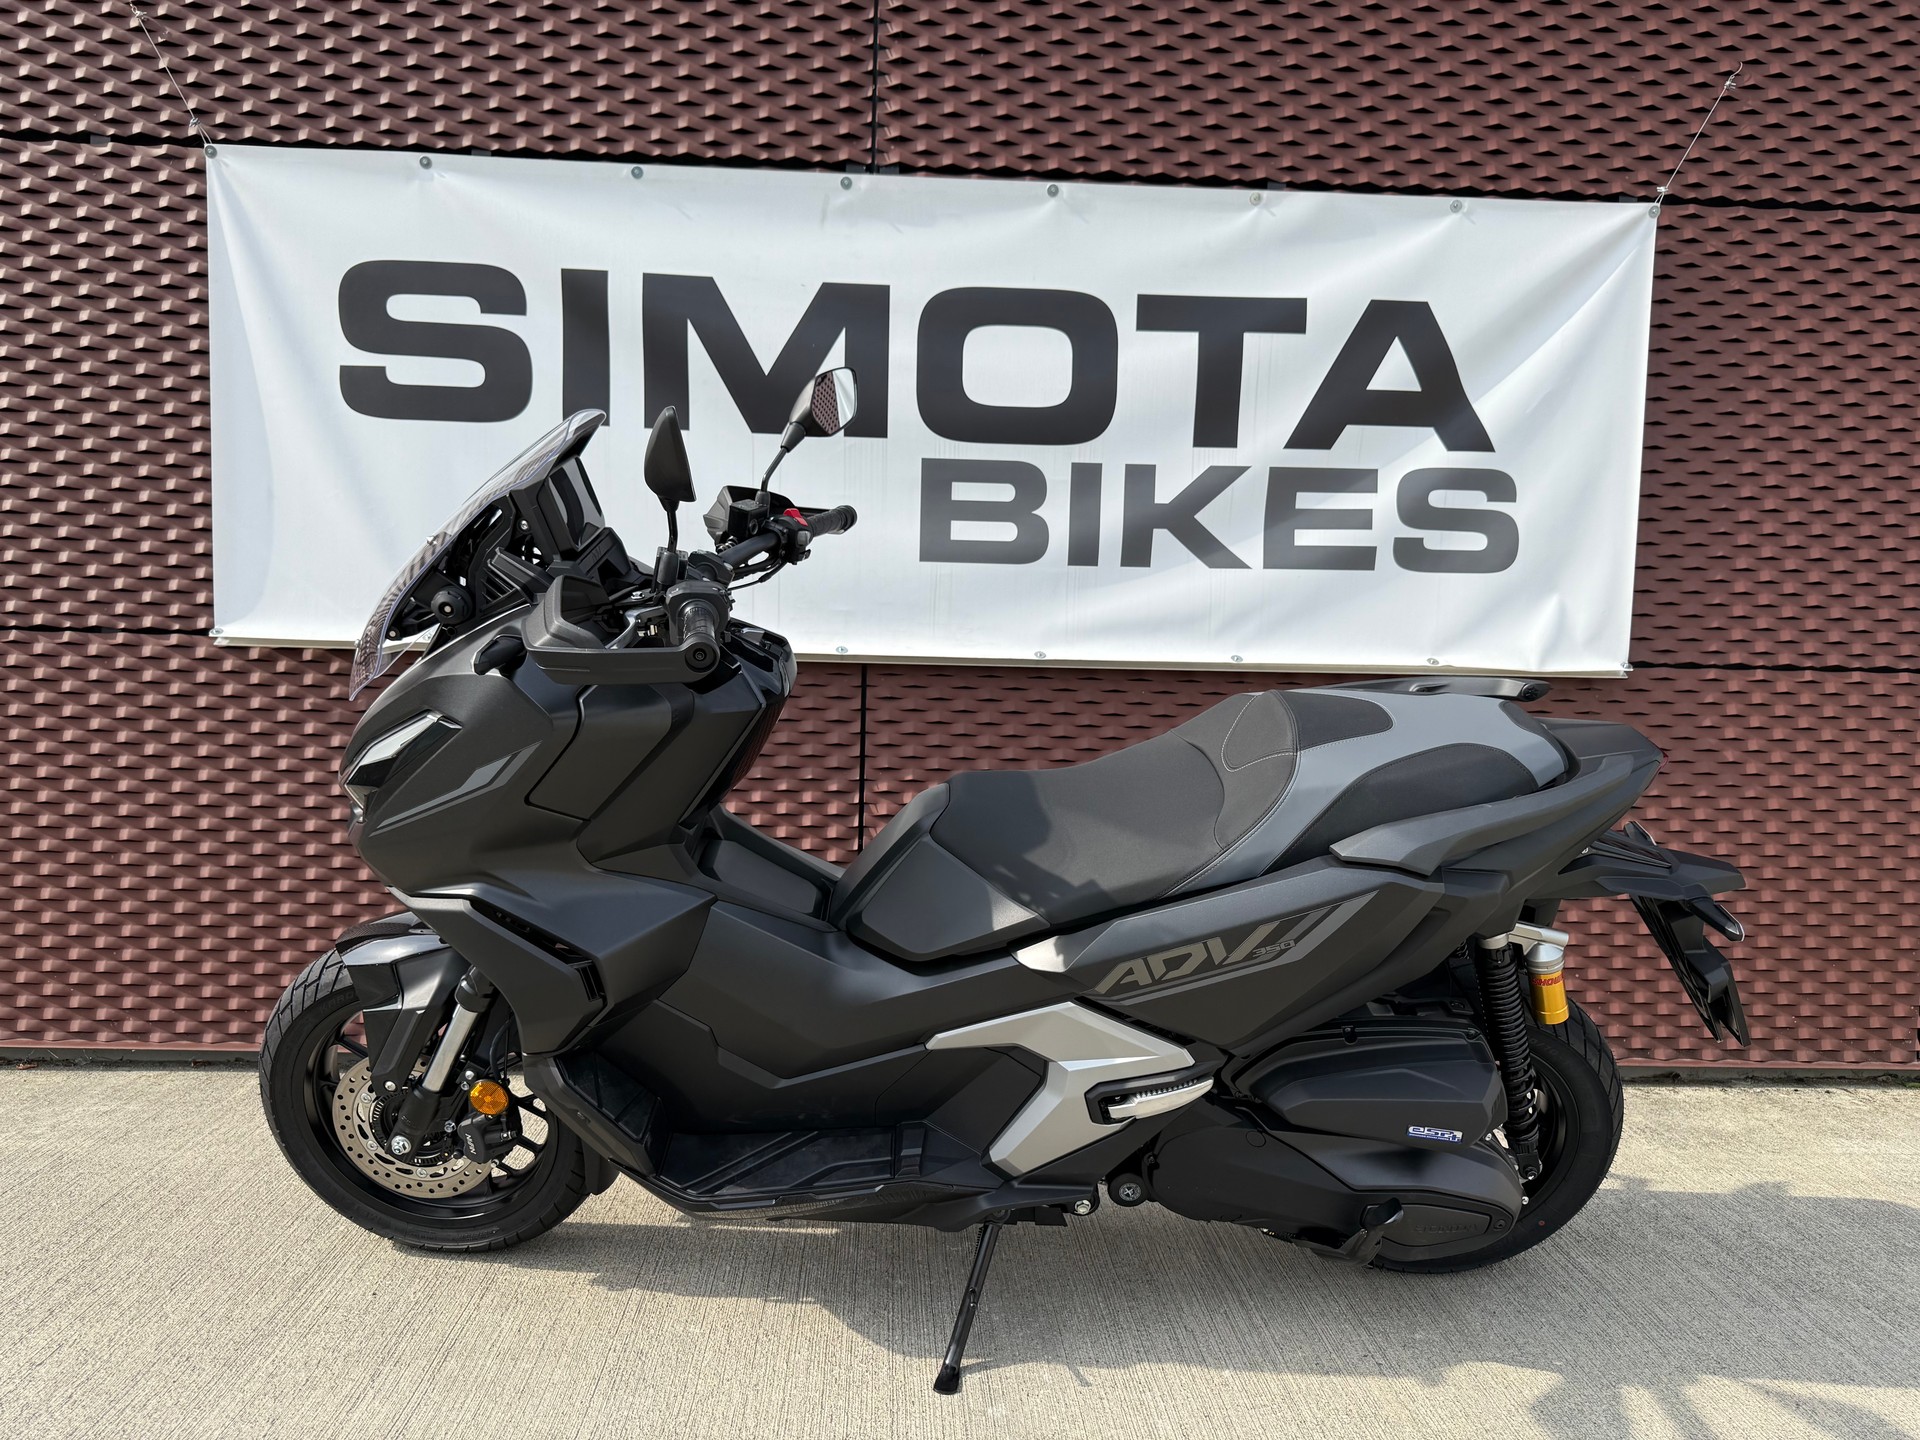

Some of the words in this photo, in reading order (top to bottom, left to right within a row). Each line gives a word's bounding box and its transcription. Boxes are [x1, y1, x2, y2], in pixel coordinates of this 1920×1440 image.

[338, 259, 1496, 453] SIMOTA
[919, 457, 1520, 574] BIKES
[1094, 920, 1280, 995] ADV
[1252, 938, 1296, 958] 350
